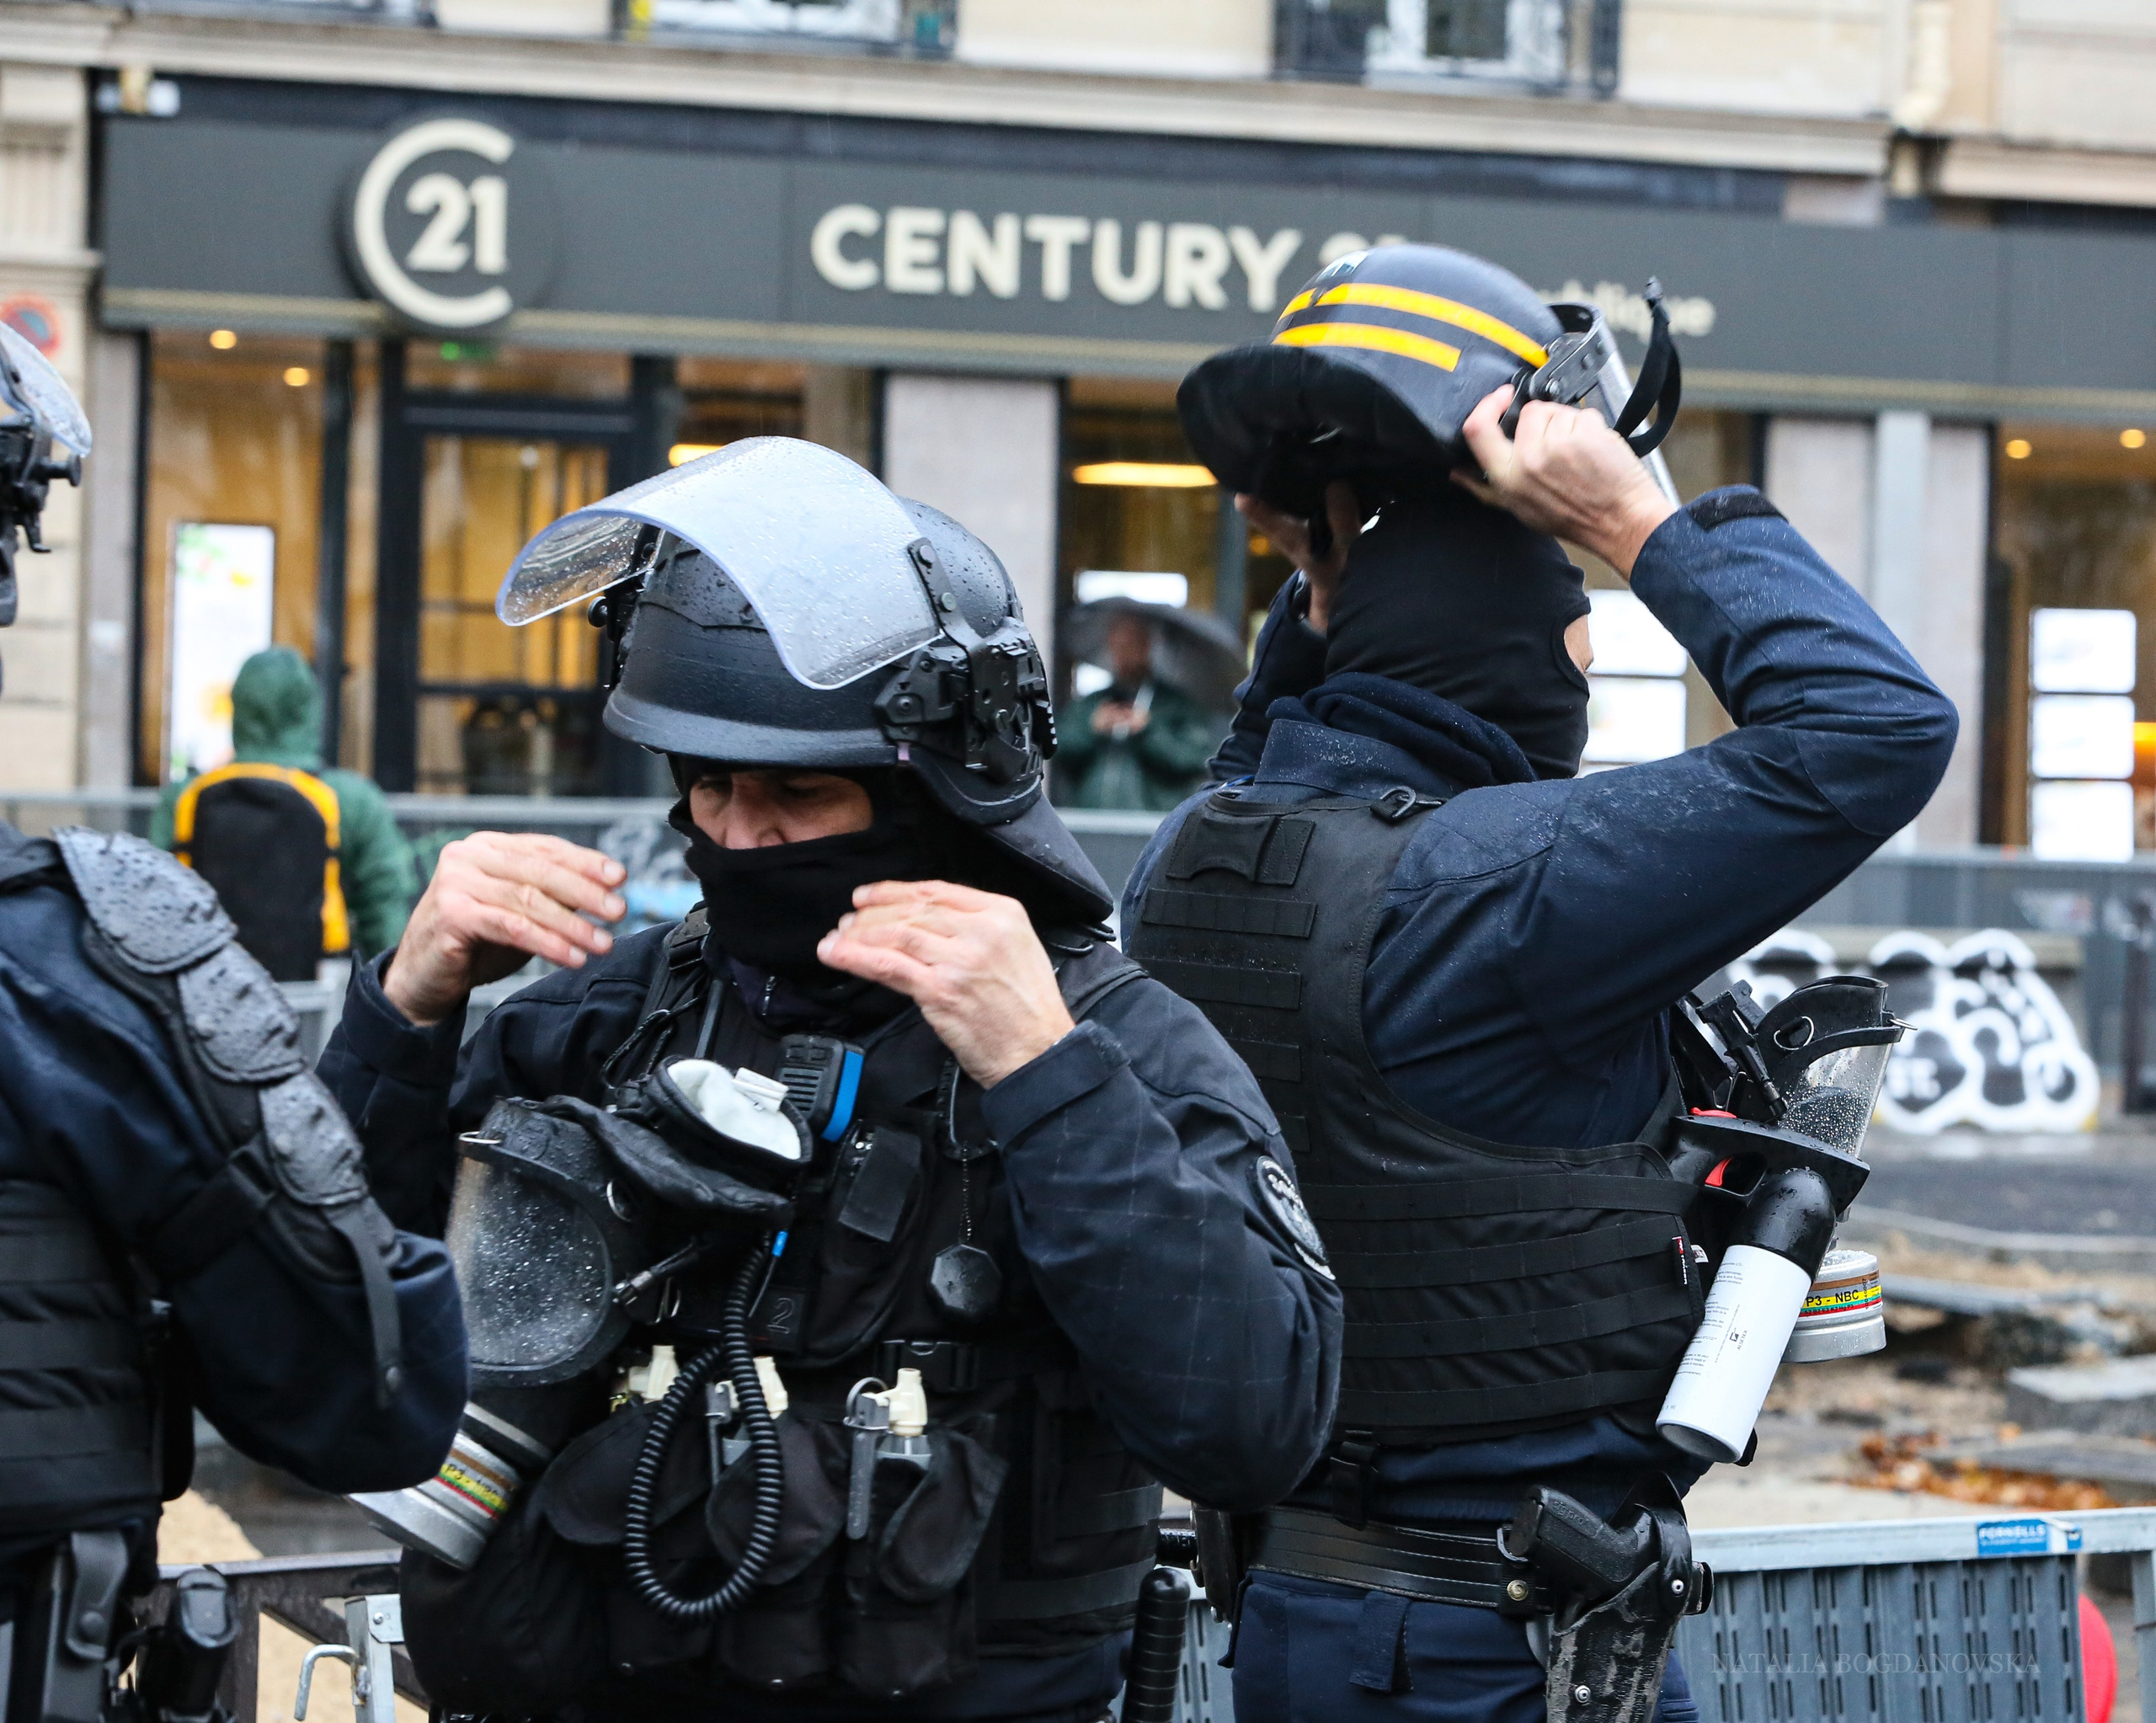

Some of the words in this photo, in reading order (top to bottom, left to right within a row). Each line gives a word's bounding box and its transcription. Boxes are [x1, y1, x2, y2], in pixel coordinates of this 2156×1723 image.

[406, 173, 507, 274] 21
[810, 204, 1302, 313] CENTURY
[767, 1297, 795, 1335] 2
[1806, 1295, 1822, 1307] P3
[1835, 1289, 1859, 1304] NBC
